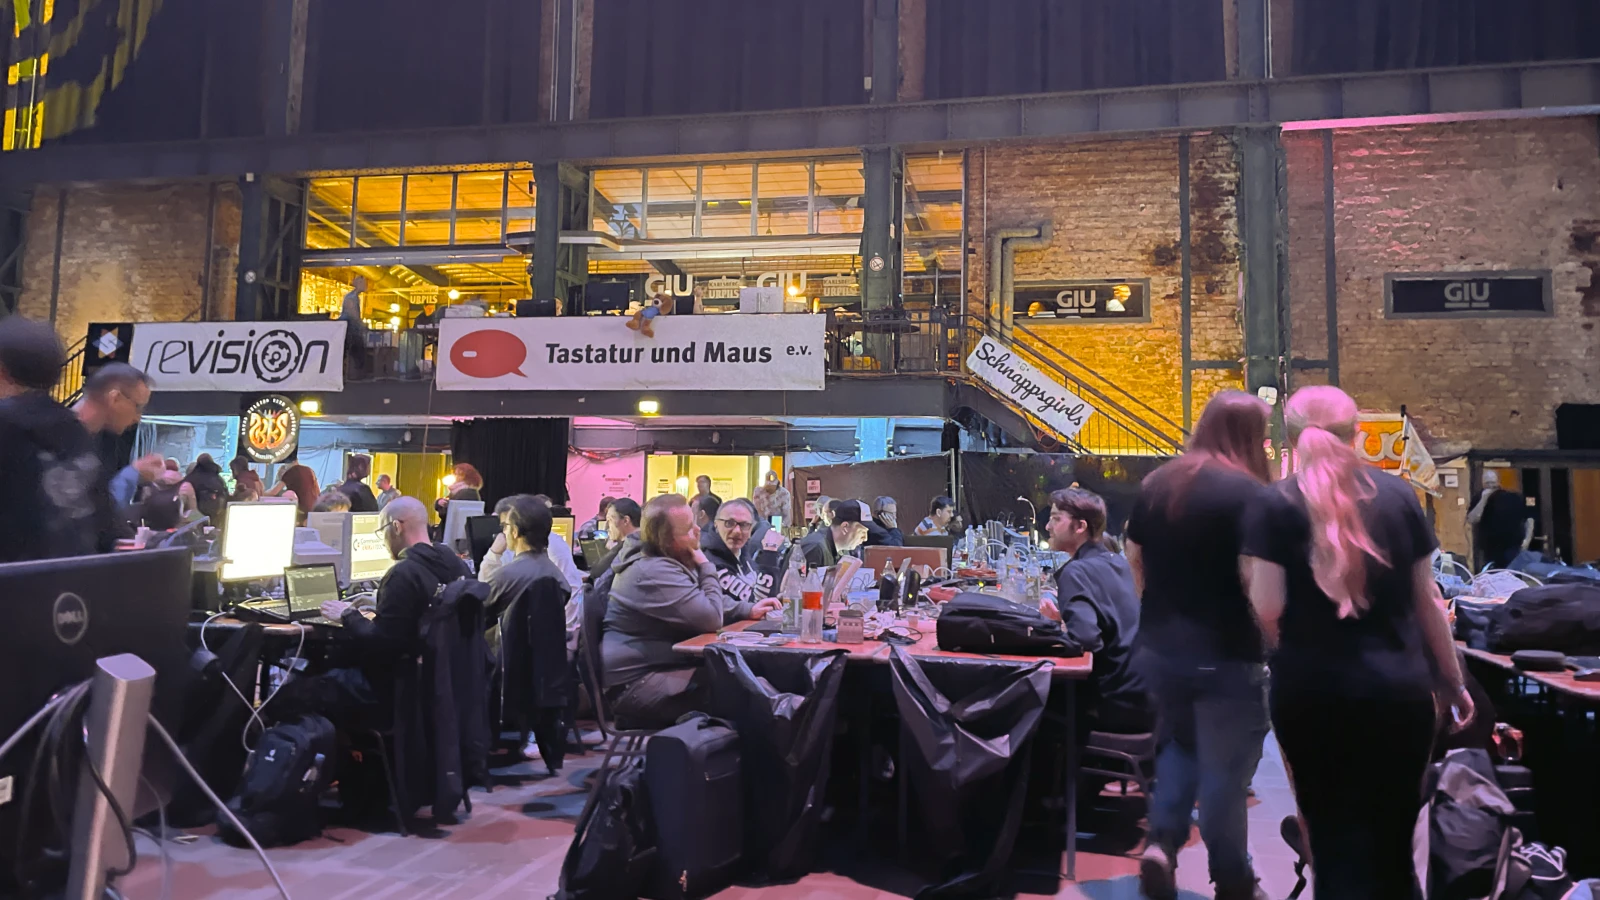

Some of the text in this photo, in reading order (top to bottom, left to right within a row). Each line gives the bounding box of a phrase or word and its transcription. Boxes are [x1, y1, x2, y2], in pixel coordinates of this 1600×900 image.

[645, 273, 693, 298] GIU
[1444, 282, 1490, 301] GIU
[410, 295, 438, 305] URPILS
[1056, 290, 1096, 308] GIU
[545, 342, 645, 364] Tastatur
[651, 341, 696, 364] und
[703, 341, 772, 364] Maus
[975, 342, 1085, 426] Schnappsgirls
